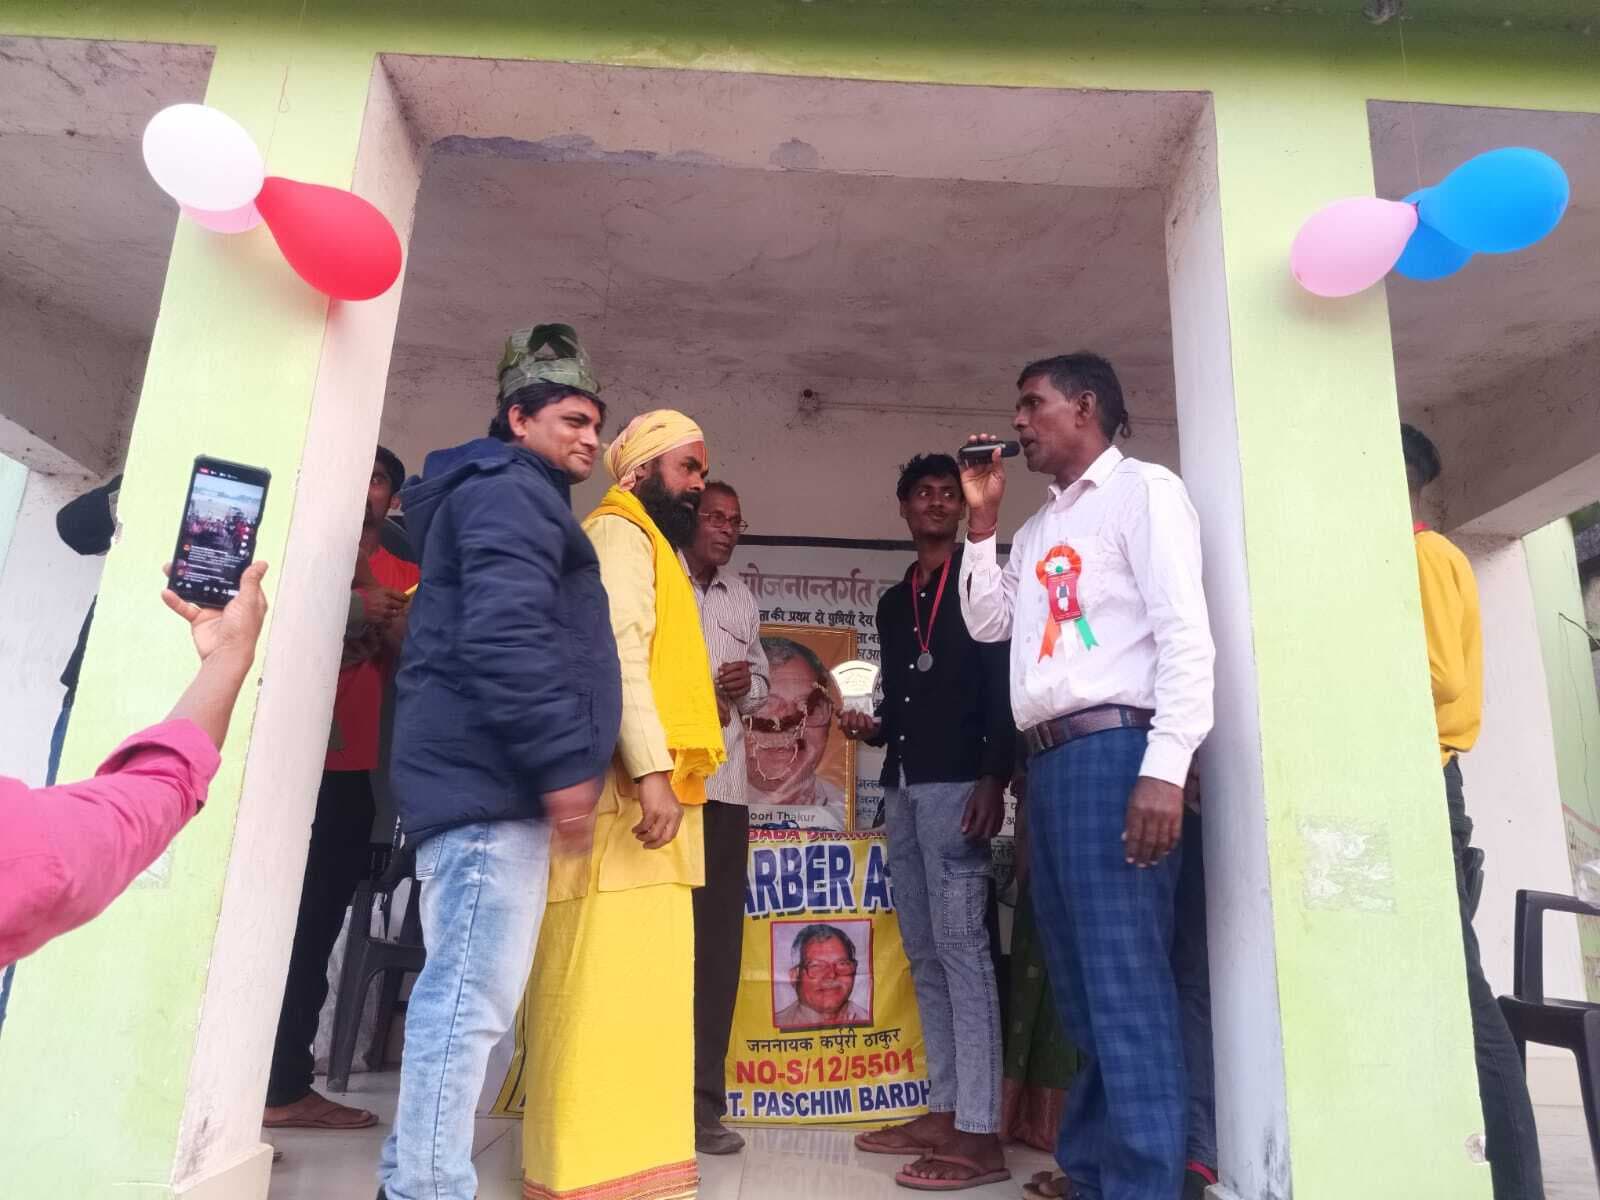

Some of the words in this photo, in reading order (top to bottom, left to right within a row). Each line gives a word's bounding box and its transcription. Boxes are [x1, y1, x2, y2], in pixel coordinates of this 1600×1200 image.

[746, 1038, 814, 1053] जननायक
[863, 1028, 902, 1049] ठाकुर
[735, 1047, 916, 1086] NO-S/12/5501
[753, 1087, 853, 1117] PASCHIM
